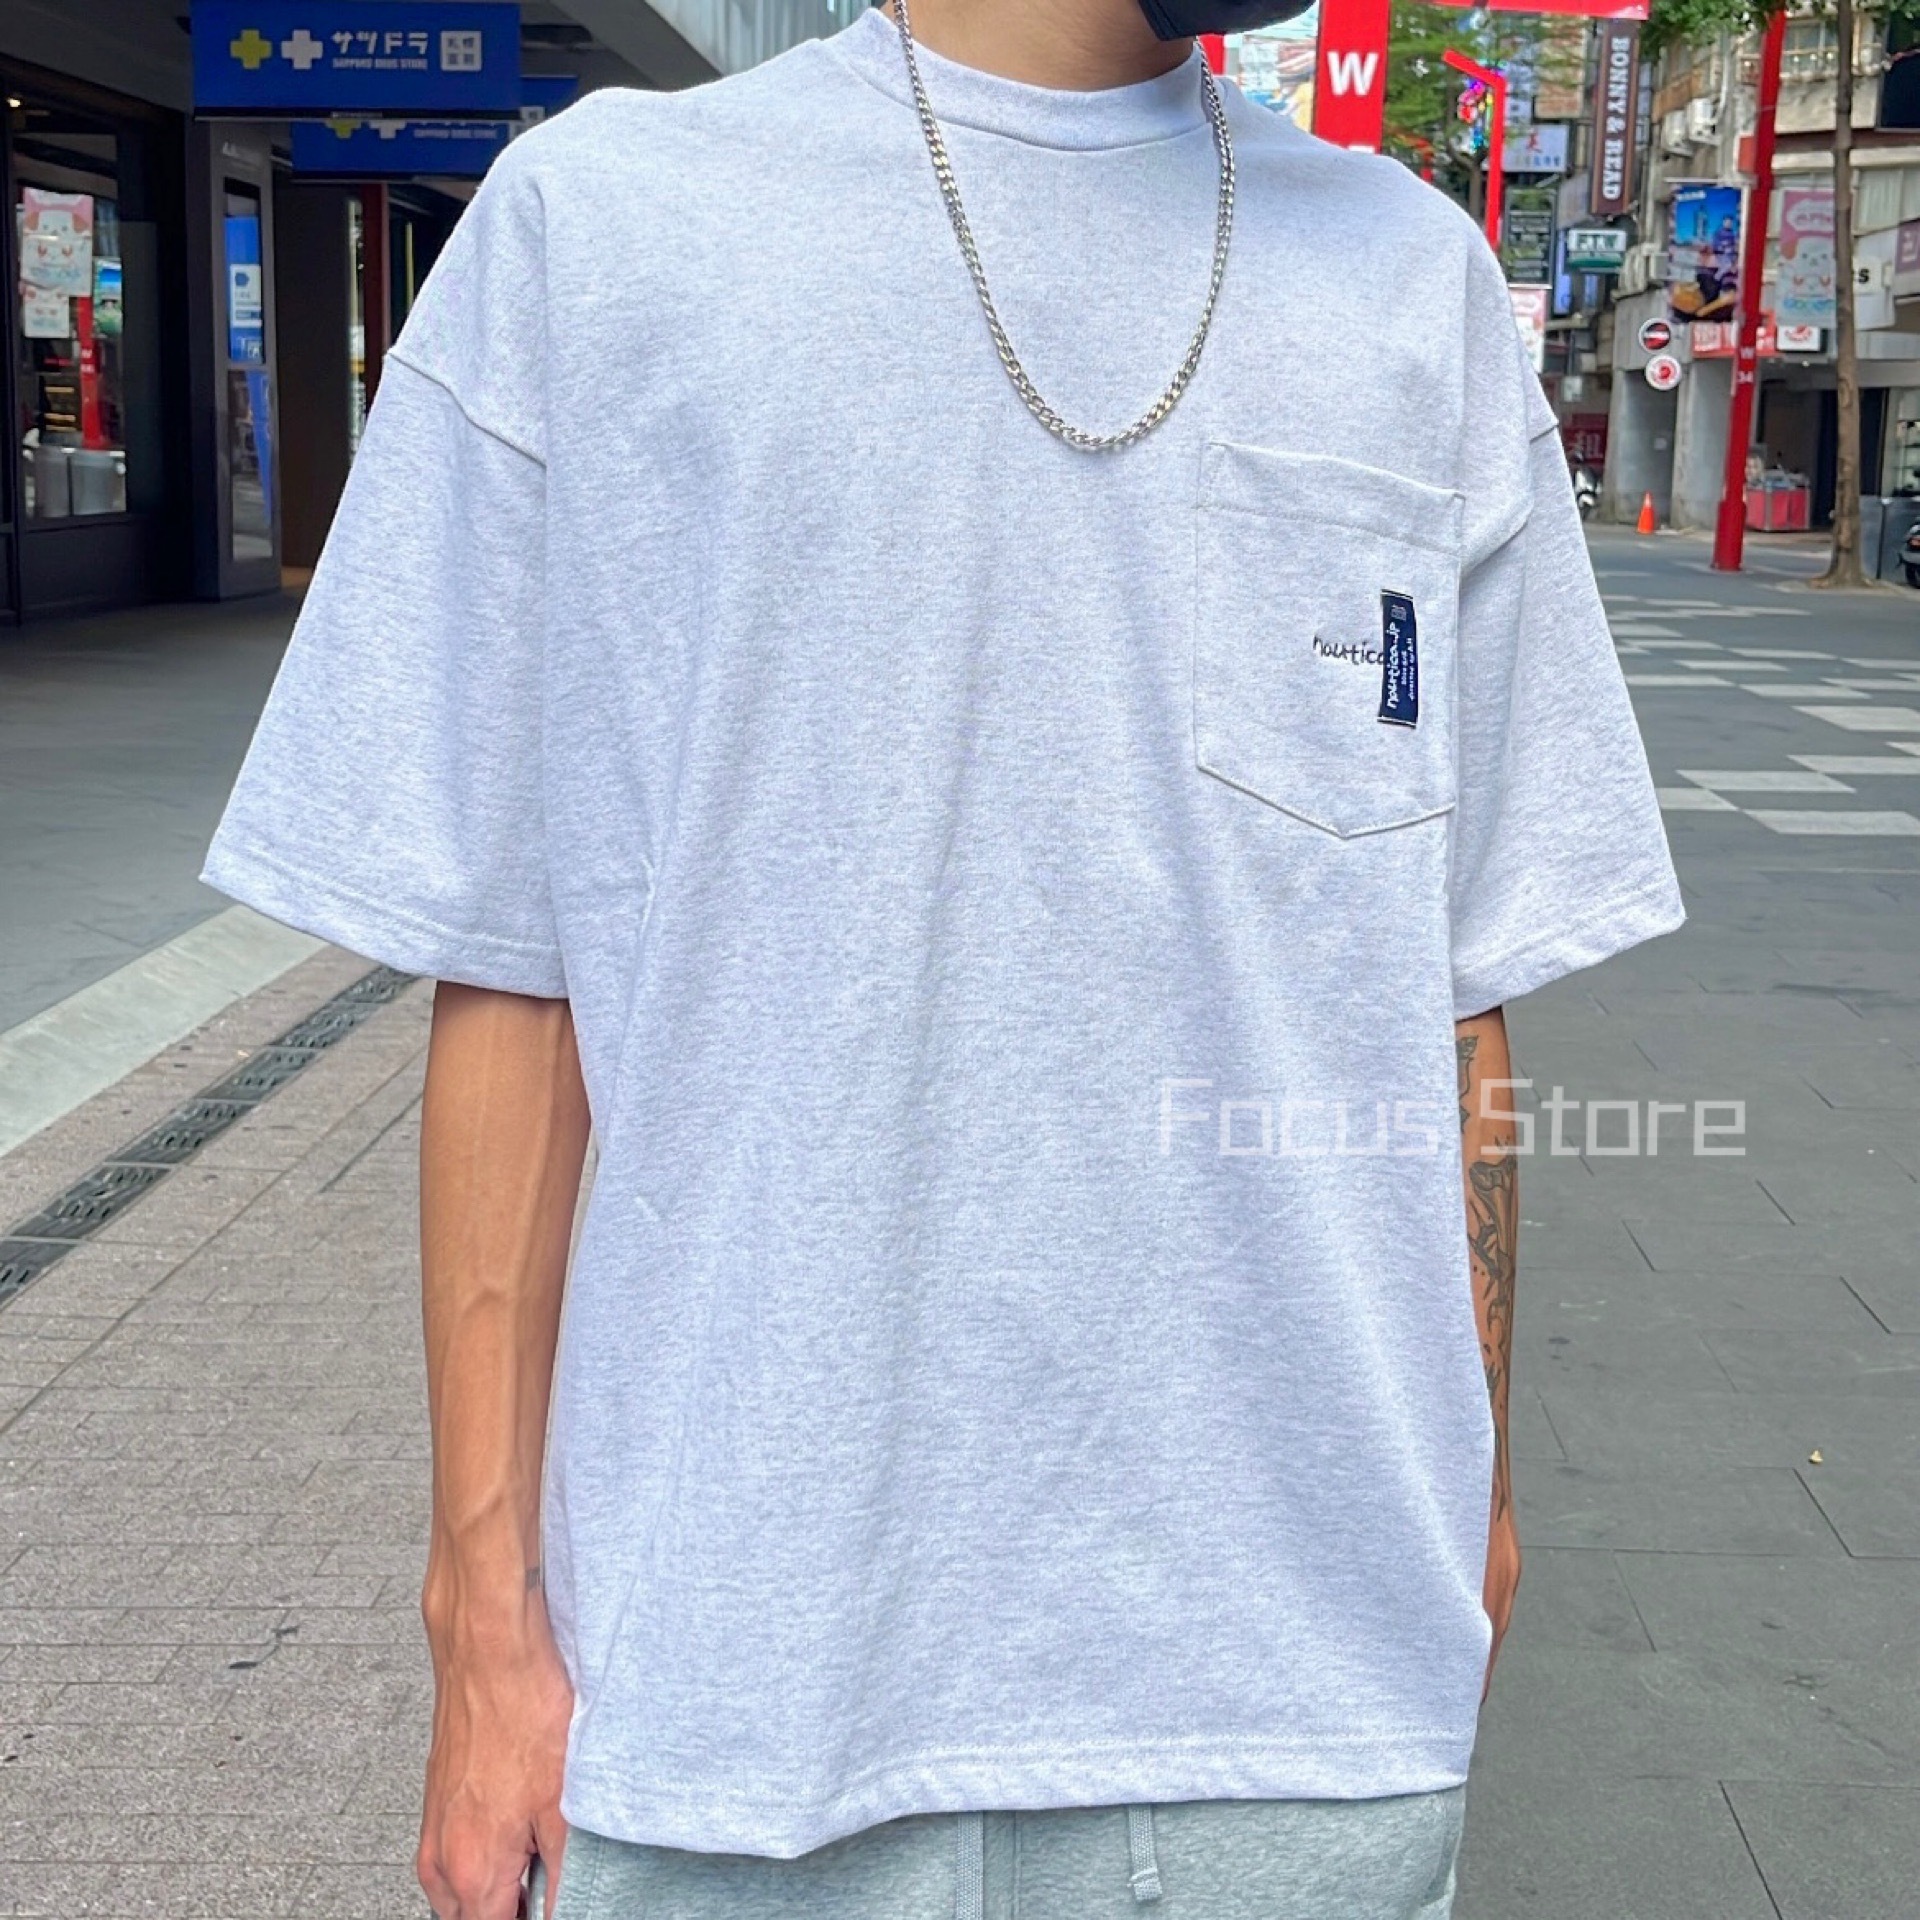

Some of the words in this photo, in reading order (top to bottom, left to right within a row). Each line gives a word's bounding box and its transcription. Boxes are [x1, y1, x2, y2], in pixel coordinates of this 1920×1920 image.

[331, 30, 428, 54] サツドラ
[1327, 52, 1378, 96] W
[1606, 37, 1631, 114] BONNY
[1602, 138, 1624, 200] READ
